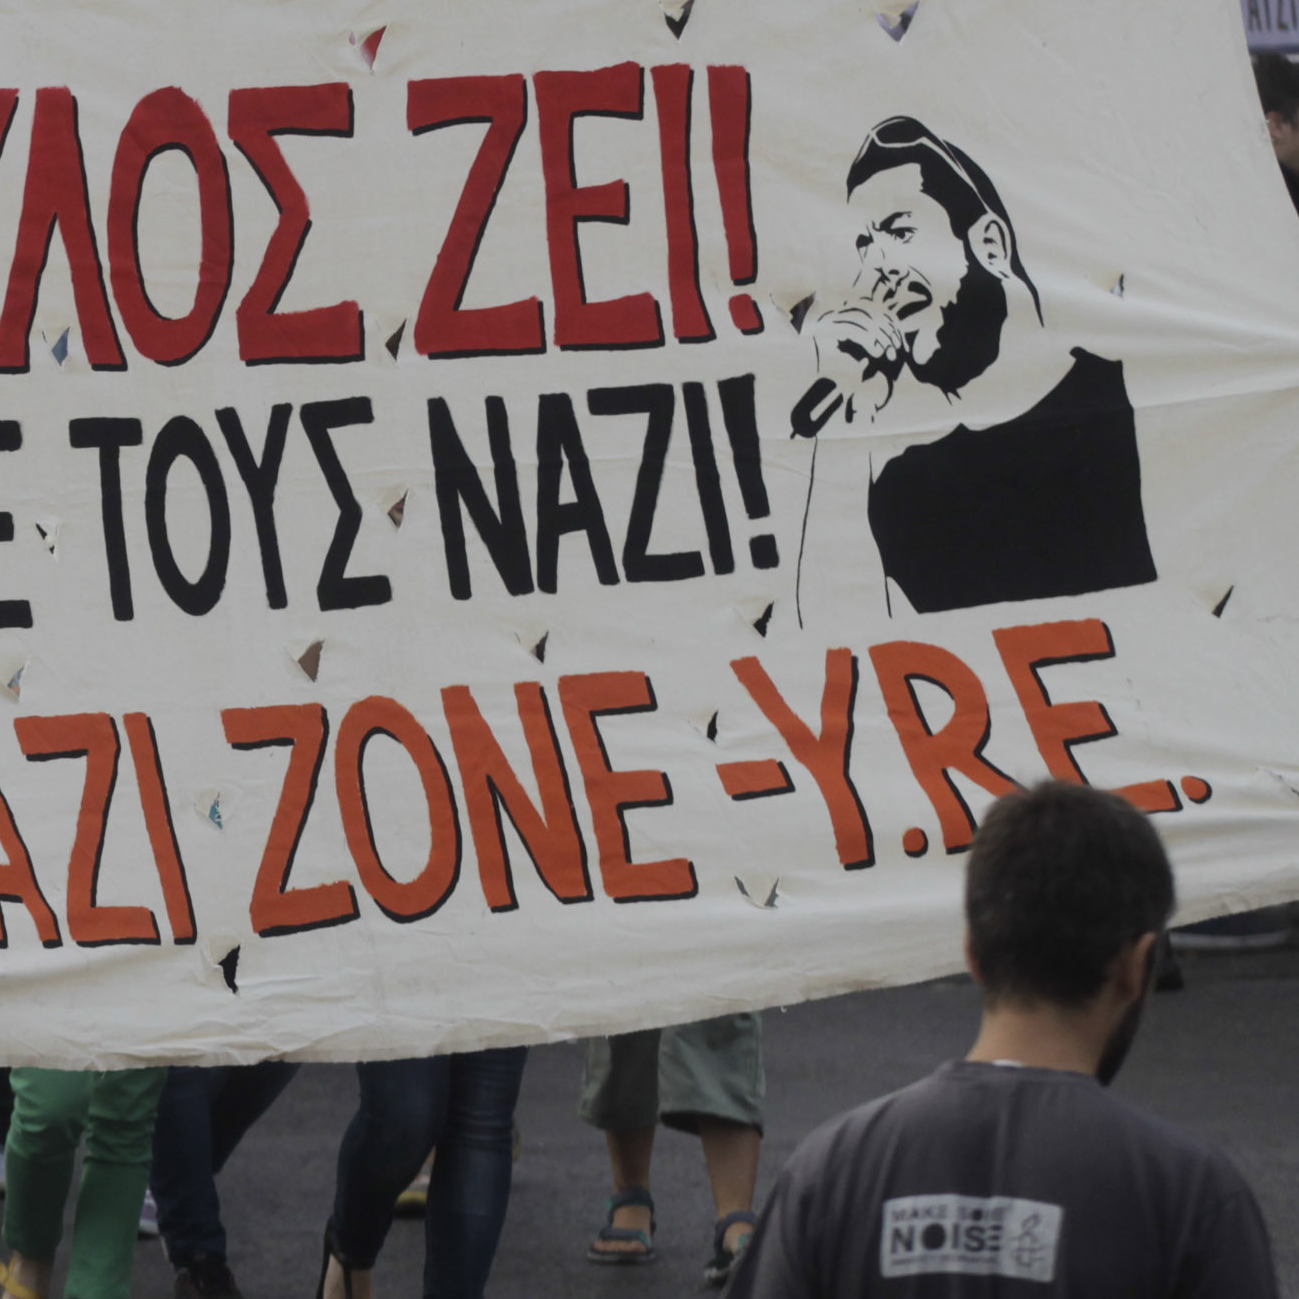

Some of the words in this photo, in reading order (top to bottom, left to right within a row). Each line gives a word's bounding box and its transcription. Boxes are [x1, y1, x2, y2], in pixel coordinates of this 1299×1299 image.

[407, 61, 764, 359] ΖΕΙ!
[69, 396, 393, 621] ΤΟΥΣ
[428, 373, 779, 601] ΝΑΖΙ!
[221, 670, 698, 938] ZONE
[890, 1222, 1003, 1254] NOISE
